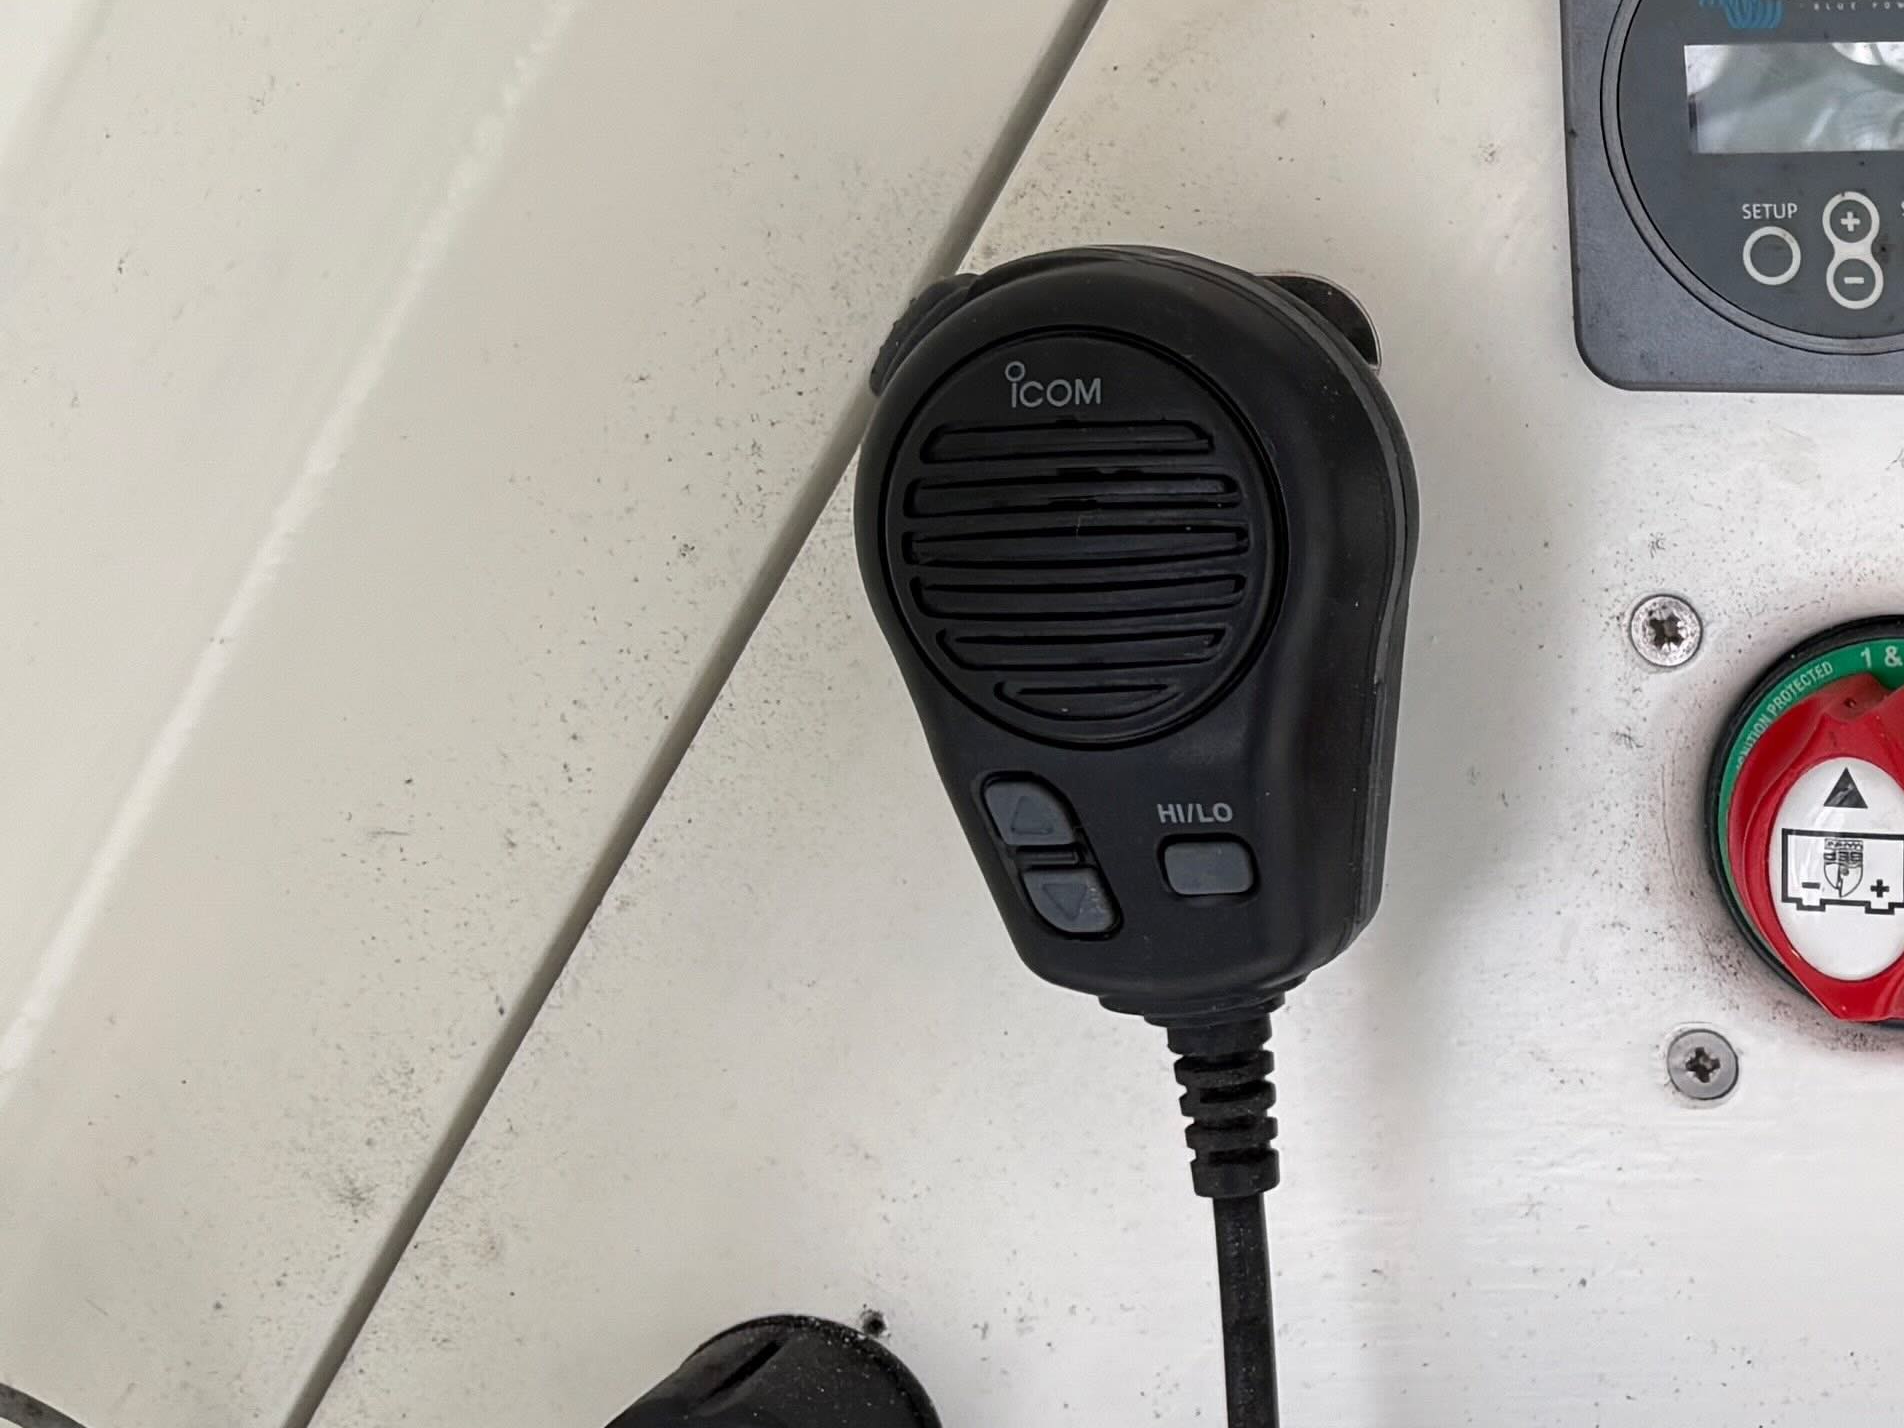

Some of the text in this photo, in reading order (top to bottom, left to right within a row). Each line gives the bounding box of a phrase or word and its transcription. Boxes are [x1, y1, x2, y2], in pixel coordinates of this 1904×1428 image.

[1813, 2, 1856, 11] BLUE
[1741, 202, 1798, 220] SETUP
[1860, 649, 1872, 668] 1
[1884, 647, 1903, 667] &
[1766, 661, 1833, 716] PROTECTED
[1156, 802, 1233, 824] HI/LO
